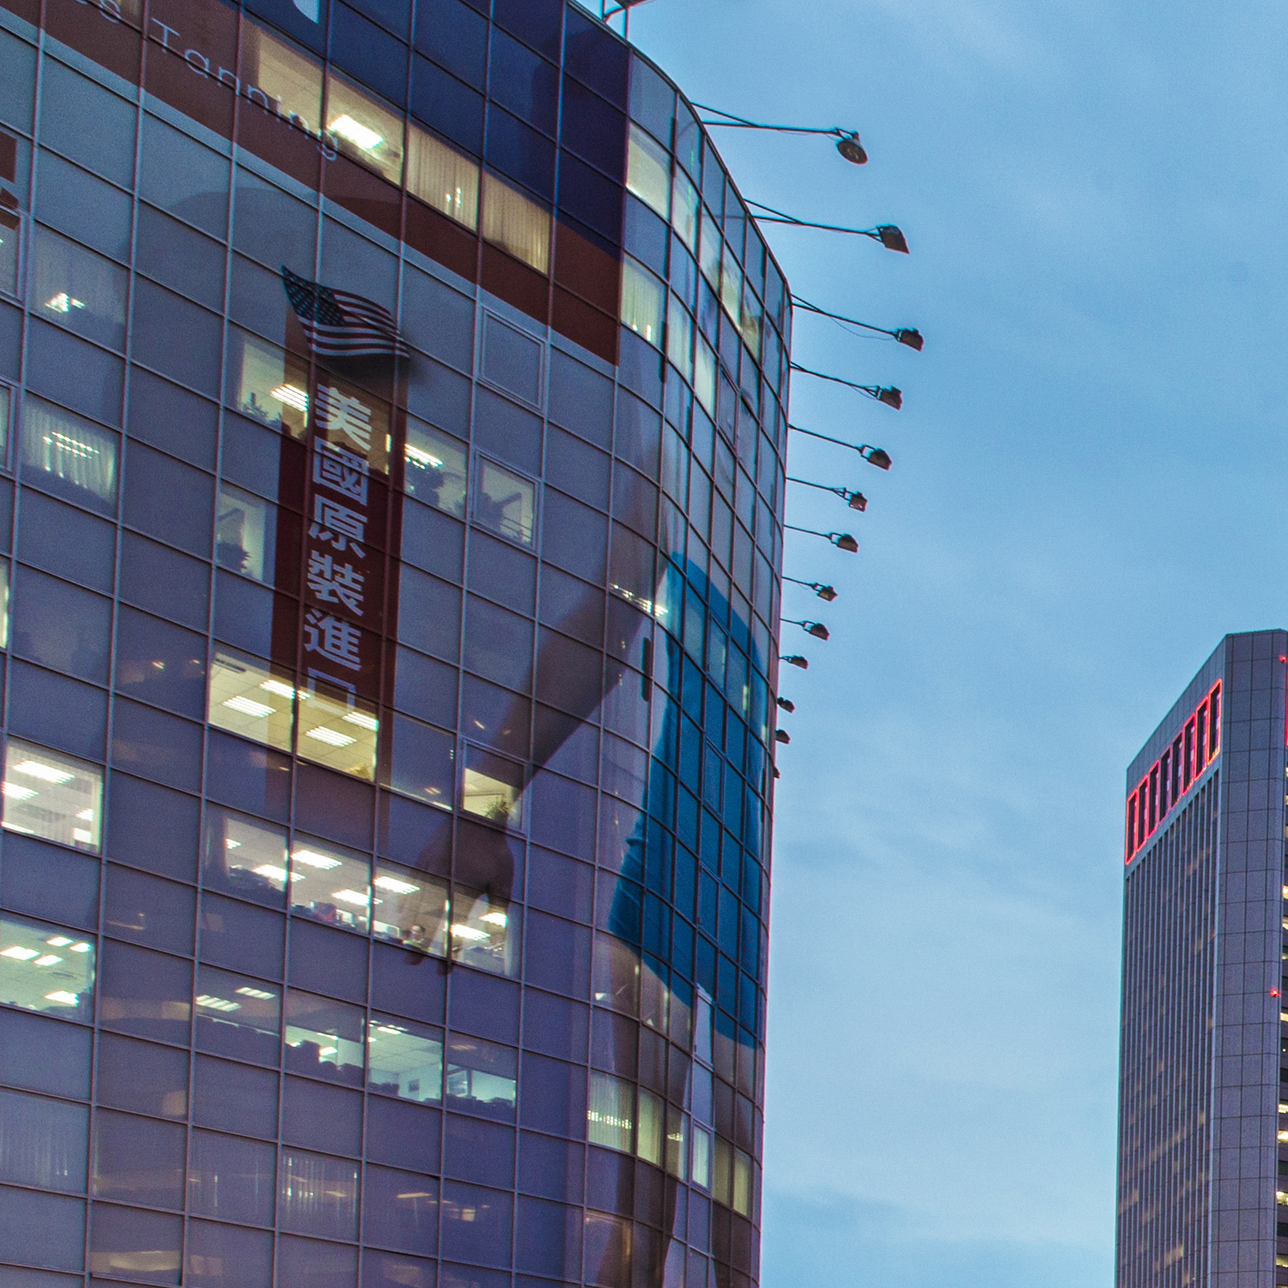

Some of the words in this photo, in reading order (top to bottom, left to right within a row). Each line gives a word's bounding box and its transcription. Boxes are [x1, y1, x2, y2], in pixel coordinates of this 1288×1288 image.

[150, 16, 338, 161] Tanning
[304, 382, 372, 715] 美國原裝進口
